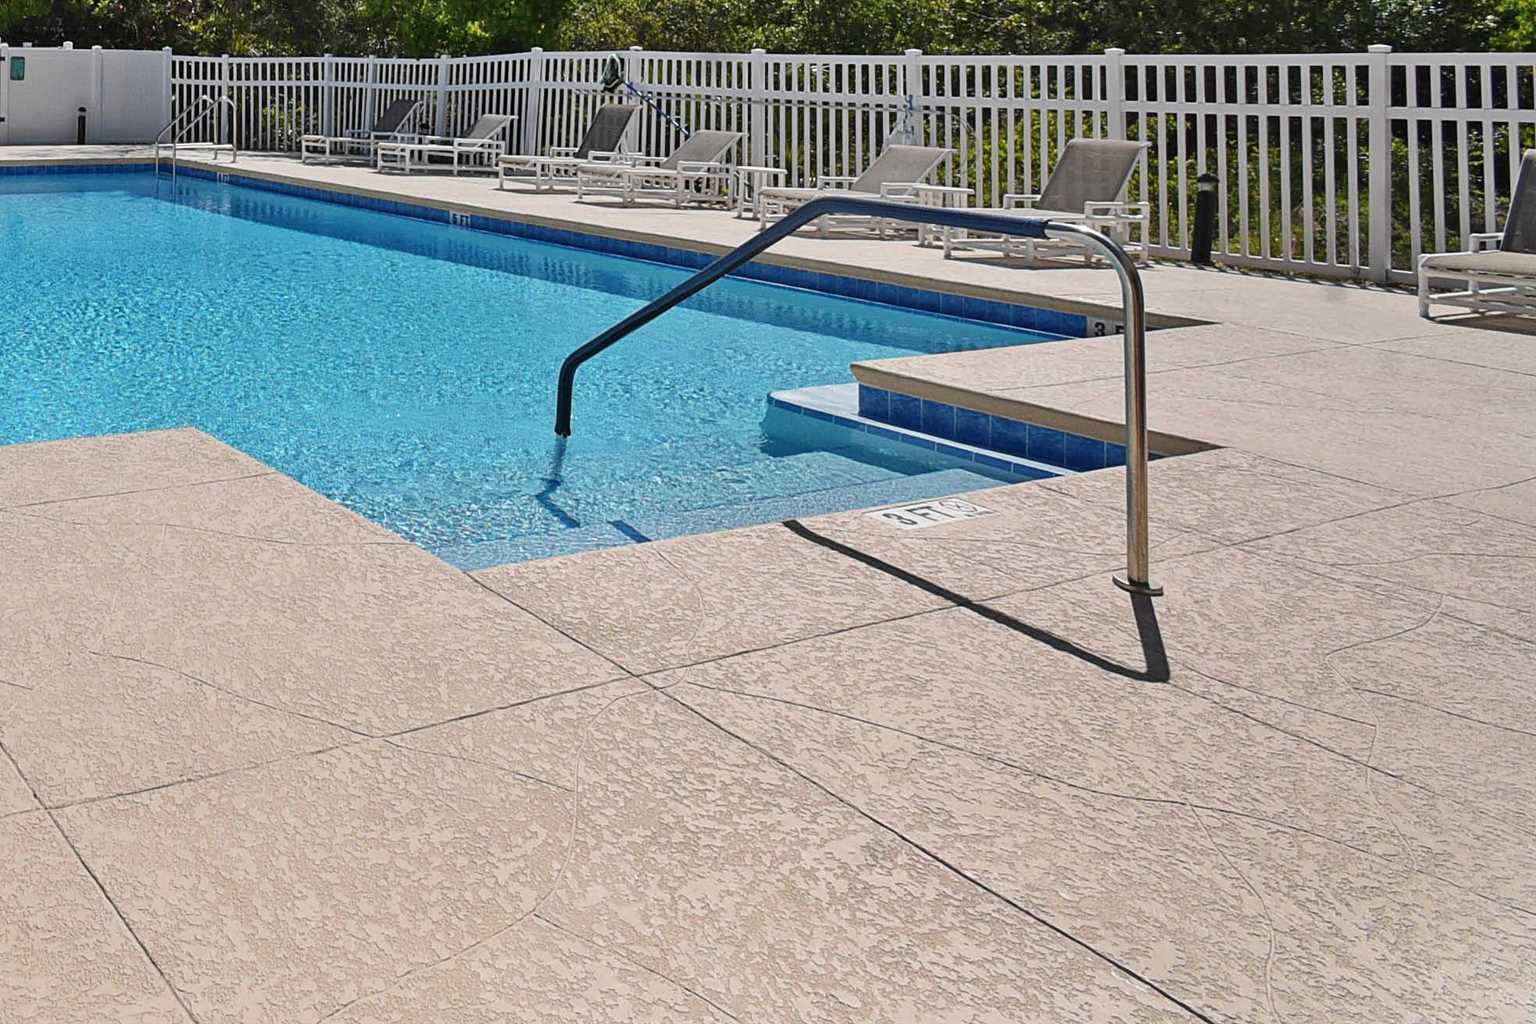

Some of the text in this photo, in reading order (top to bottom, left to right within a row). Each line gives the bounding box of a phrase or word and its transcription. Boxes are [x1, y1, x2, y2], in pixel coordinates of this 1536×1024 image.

[1094, 322, 1105, 336] 3
[882, 513, 919, 526] 3
[905, 506, 955, 522] FT
